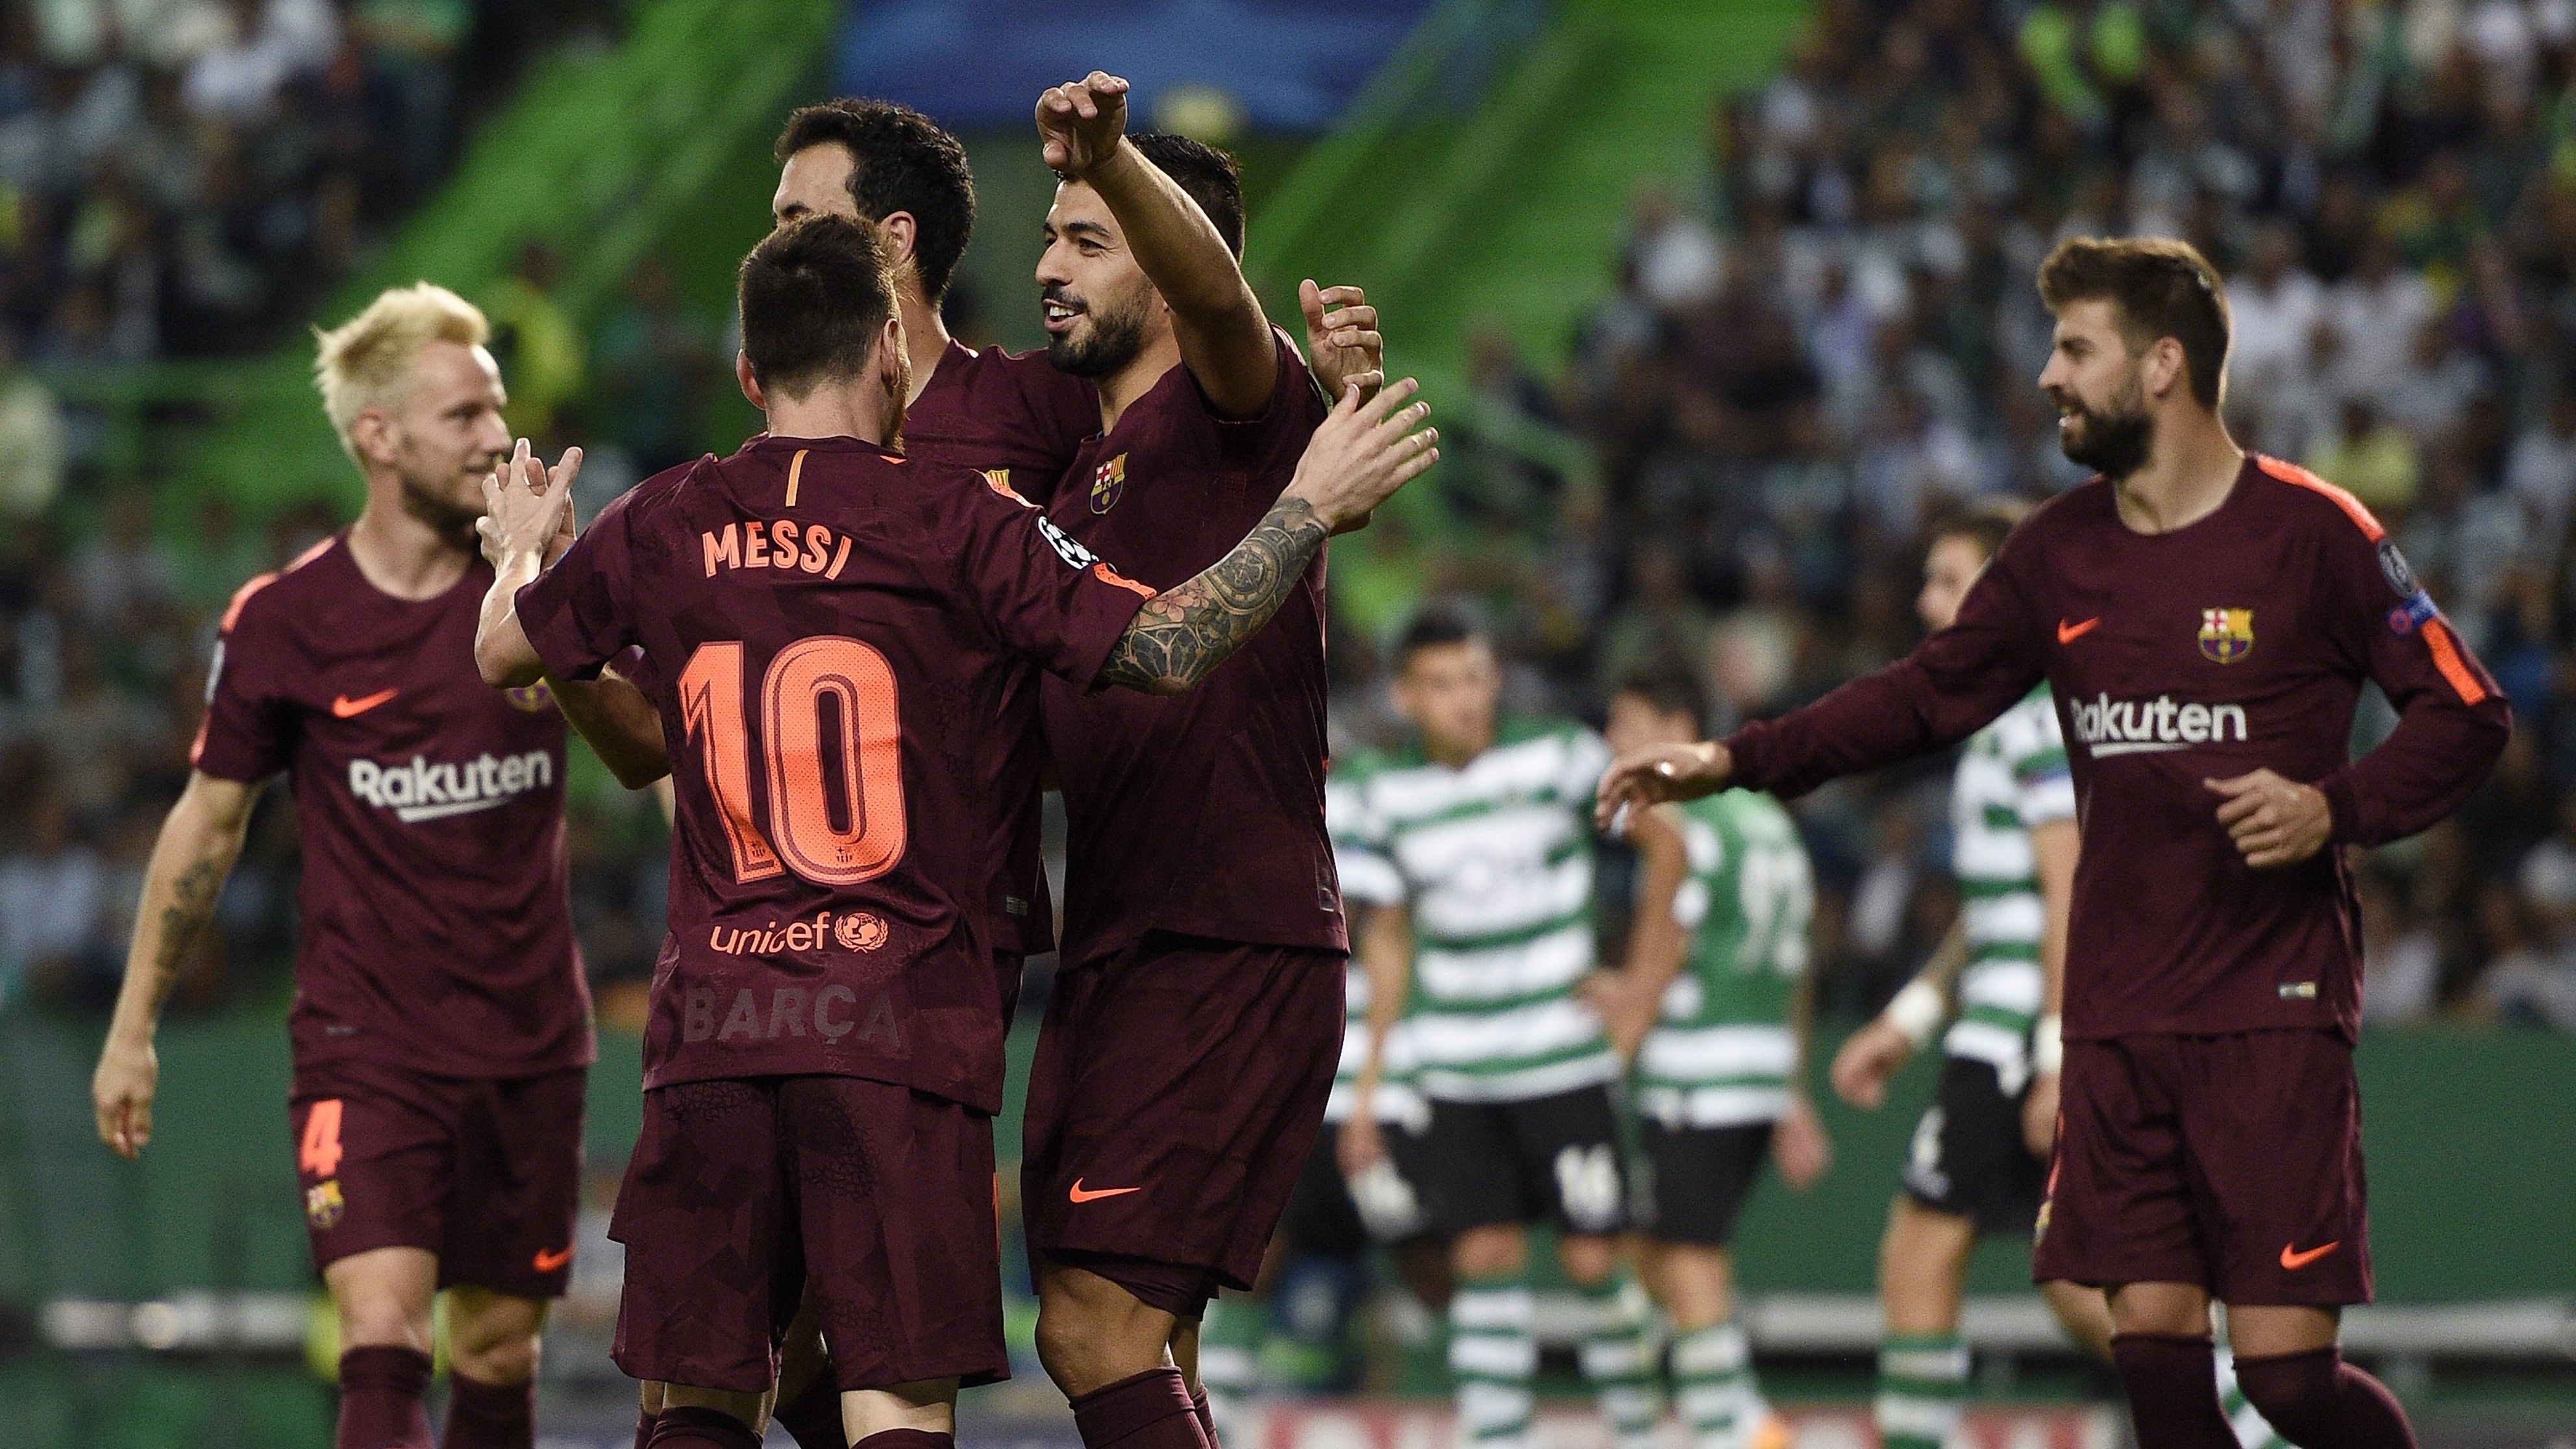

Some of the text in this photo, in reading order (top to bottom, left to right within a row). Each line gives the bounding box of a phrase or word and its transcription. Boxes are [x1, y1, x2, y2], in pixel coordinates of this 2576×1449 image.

[702, 520, 852, 580] MESSI
[349, 750, 552, 807] Rakuten
[679, 636, 907, 885] 10
[710, 911, 830, 956] unicef
[683, 984, 900, 1046] BARÇA
[301, 1098, 343, 1178] 4
